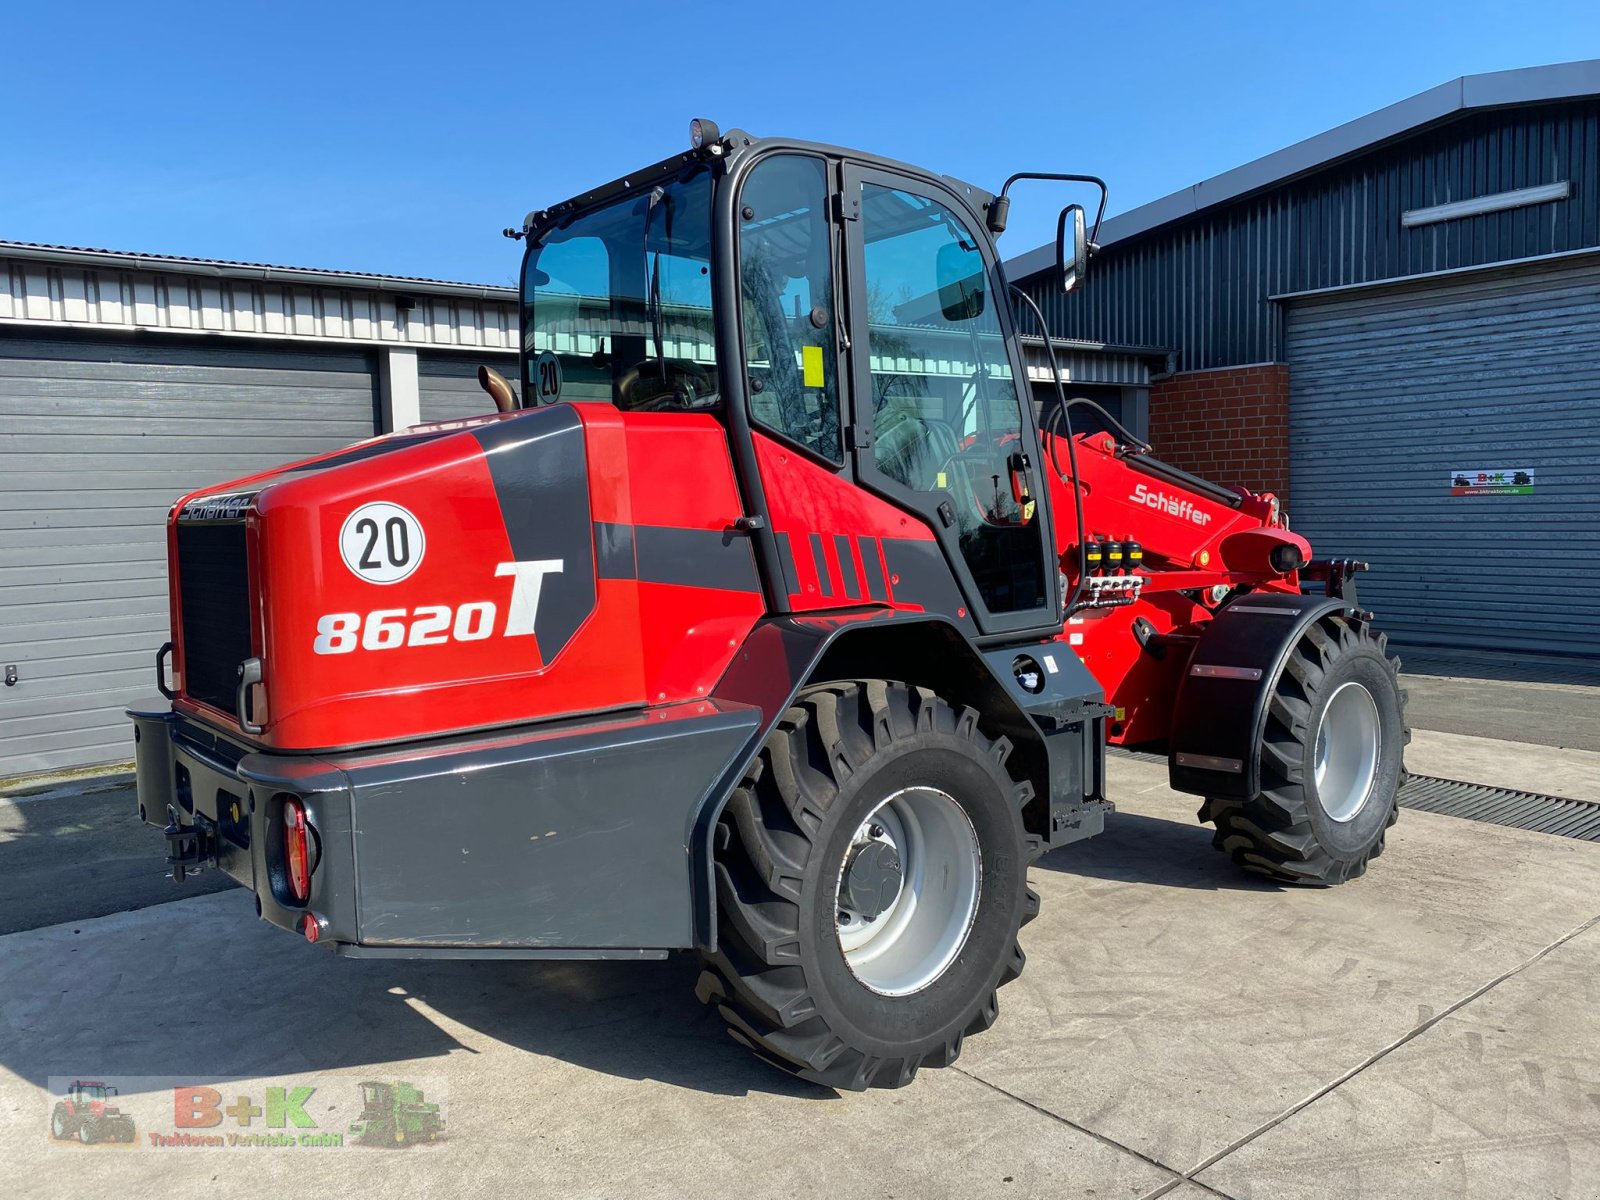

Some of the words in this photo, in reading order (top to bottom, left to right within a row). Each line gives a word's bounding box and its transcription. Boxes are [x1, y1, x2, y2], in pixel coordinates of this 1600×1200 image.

[541, 361, 557, 396] 20
[1129, 484, 1211, 526] Schäffer
[355, 516, 410, 570] 20
